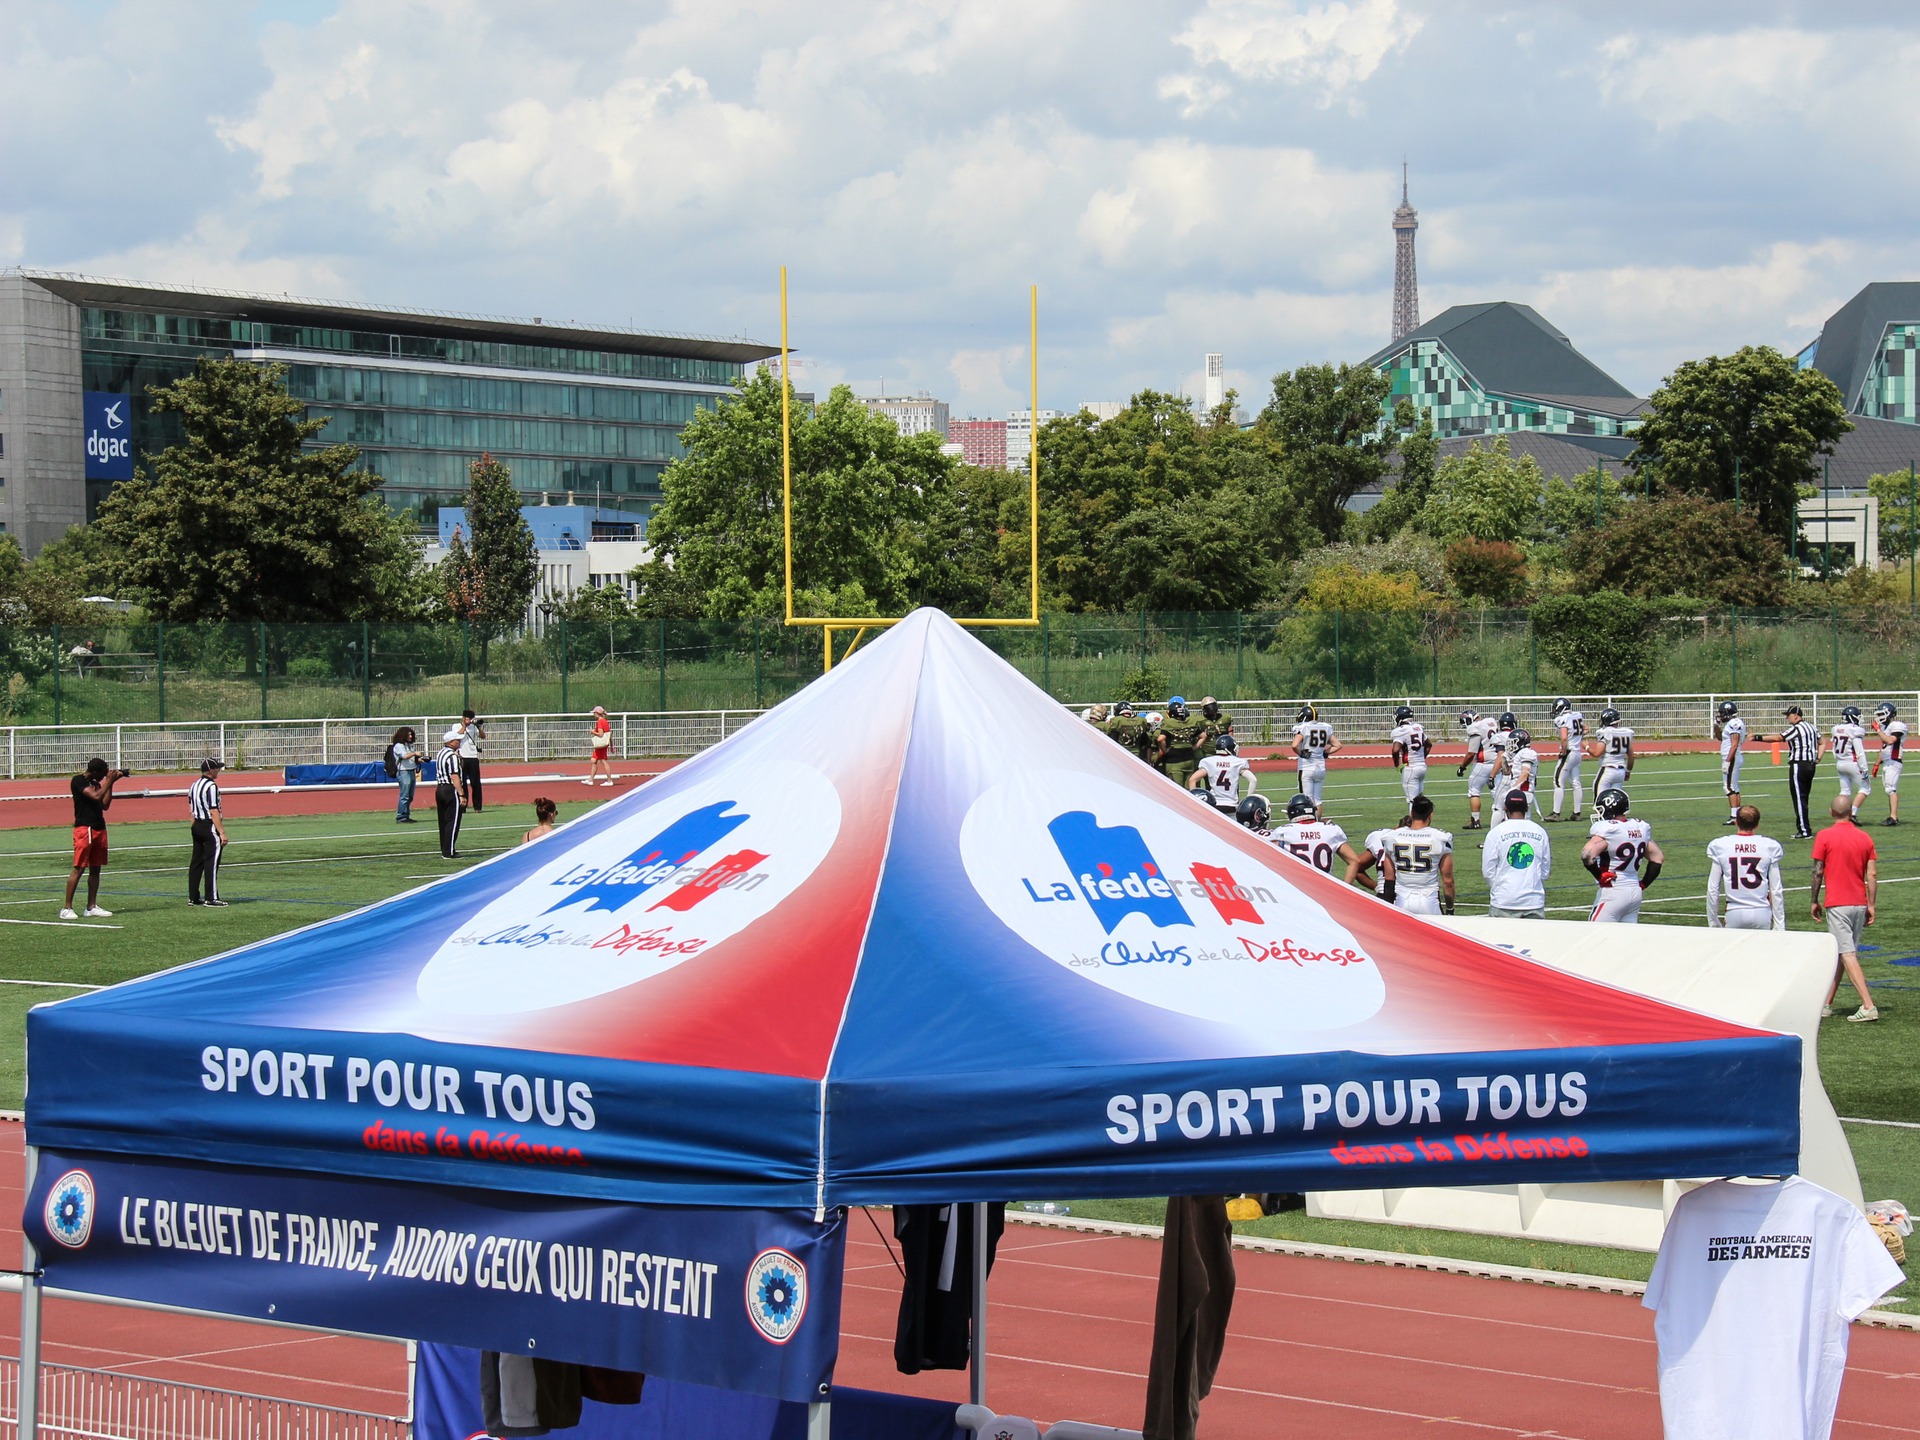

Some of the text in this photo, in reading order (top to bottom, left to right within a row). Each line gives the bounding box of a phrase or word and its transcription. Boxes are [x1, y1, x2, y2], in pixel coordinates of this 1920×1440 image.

[87, 429, 129, 464] dgac
[1309, 729, 1327, 748] 69
[1610, 736, 1630, 755] 94
[1833, 735, 1849, 754] 27
[1216, 769, 1232, 791] 4
[1300, 831, 1321, 841] PARIS
[1501, 831, 1543, 842] LUCKY WORLD
[1734, 843, 1757, 853] PARIS
[1289, 842, 1333, 874] 50
[1392, 843, 1433, 873] 55
[1614, 841, 1646, 872] 98
[550, 863, 591, 886] La
[1728, 856, 1763, 890] 13
[1021, 877, 1075, 903] La
[451, 931, 478, 946] des
[477, 923, 565, 949] Clubs
[590, 923, 708, 957] Défense
[1068, 953, 1100, 968] des
[1100, 941, 1192, 967] Clubs
[1197, 947, 1220, 961] de
[1236, 936, 1366, 967] Défense
[201, 1045, 596, 1131] SPORT POUR TOUS
[1105, 1071, 1588, 1145] SPORT POUR TOUS
[362, 1120, 589, 1167] dans la Défense
[1329, 1132, 1589, 1165] dans la Défense
[1707, 1244, 1811, 1262] DES ARMÉES
[1709, 1235, 1812, 1245] FOOTBALL AMERICAIN
[120, 1196, 151, 1245] LE
[154, 1199, 243, 1256] BLEUET
[249, 1209, 280, 1261] DE
[285, 1213, 379, 1281] FRANCE,
[382, 1225, 477, 1286] AIDONS
[475, 1235, 543, 1294] CEUX
[549, 1243, 593, 1302] QUI
[600, 1248, 718, 1319] RESTENT
